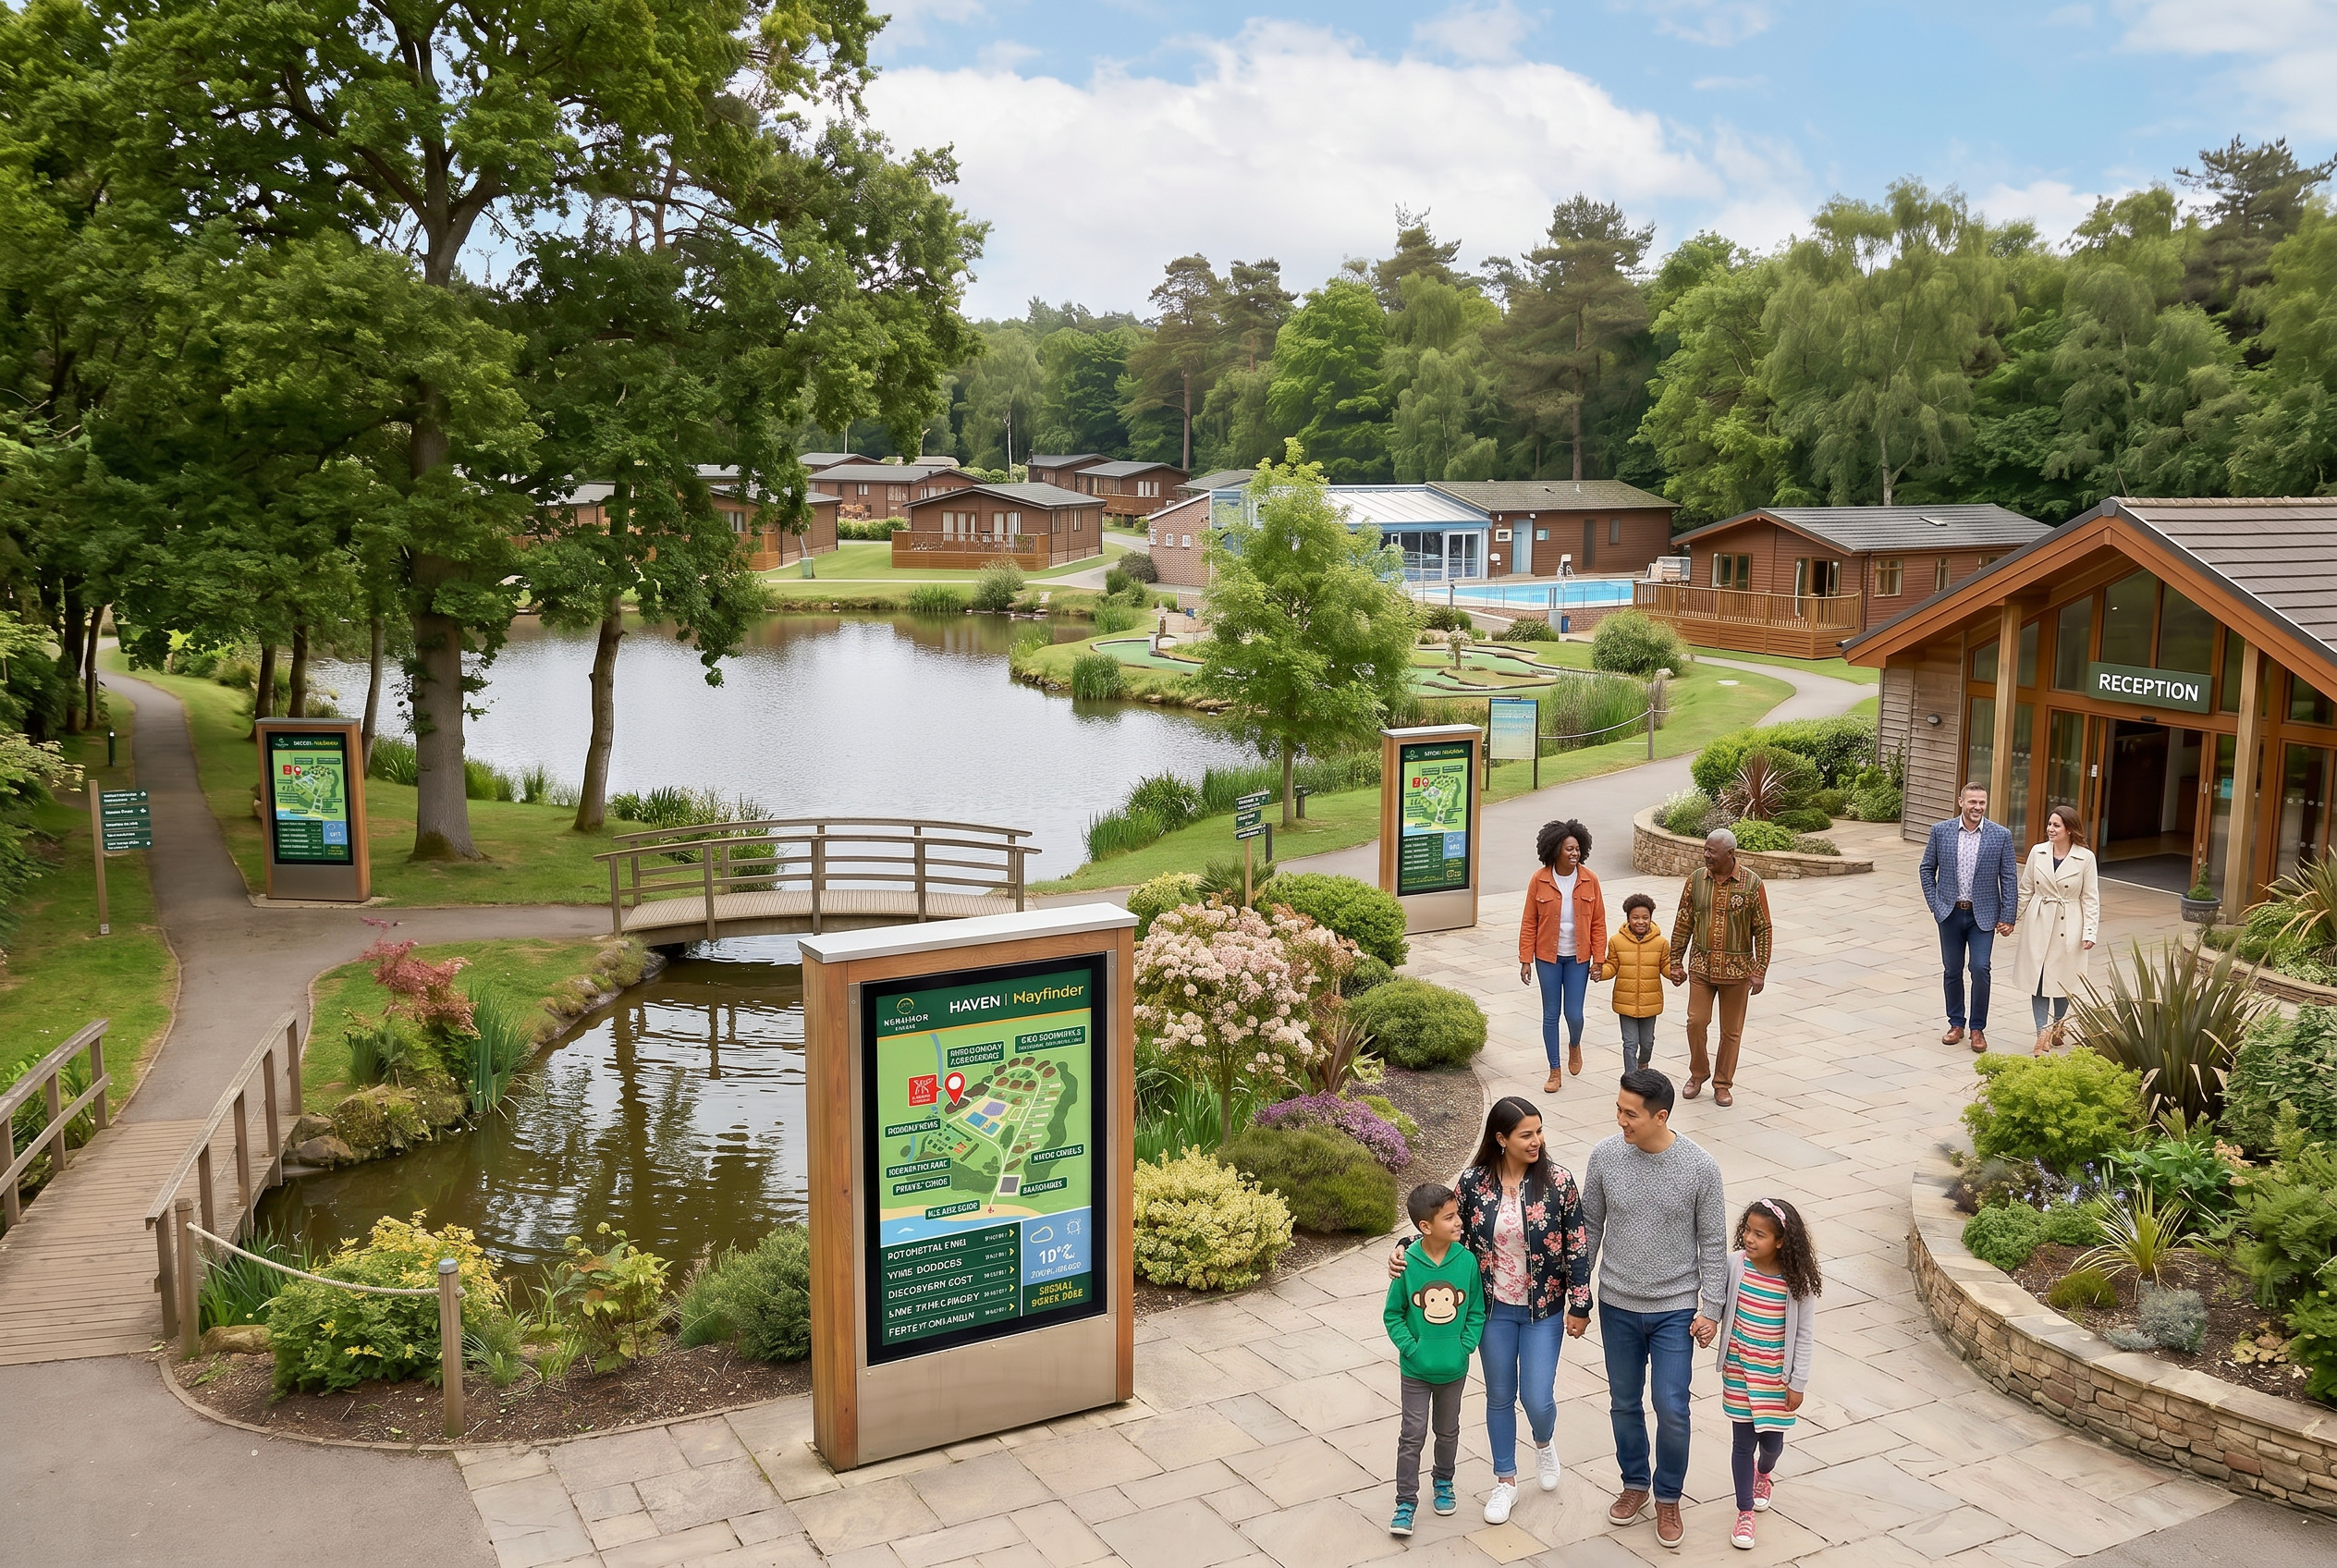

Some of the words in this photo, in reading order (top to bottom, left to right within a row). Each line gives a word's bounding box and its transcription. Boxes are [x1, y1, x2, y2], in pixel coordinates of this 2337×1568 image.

[2098, 673, 2199, 702] RECEPTION
[949, 995, 1000, 1014] HAVEN
[1013, 984, 1084, 1005] Mayfinder
